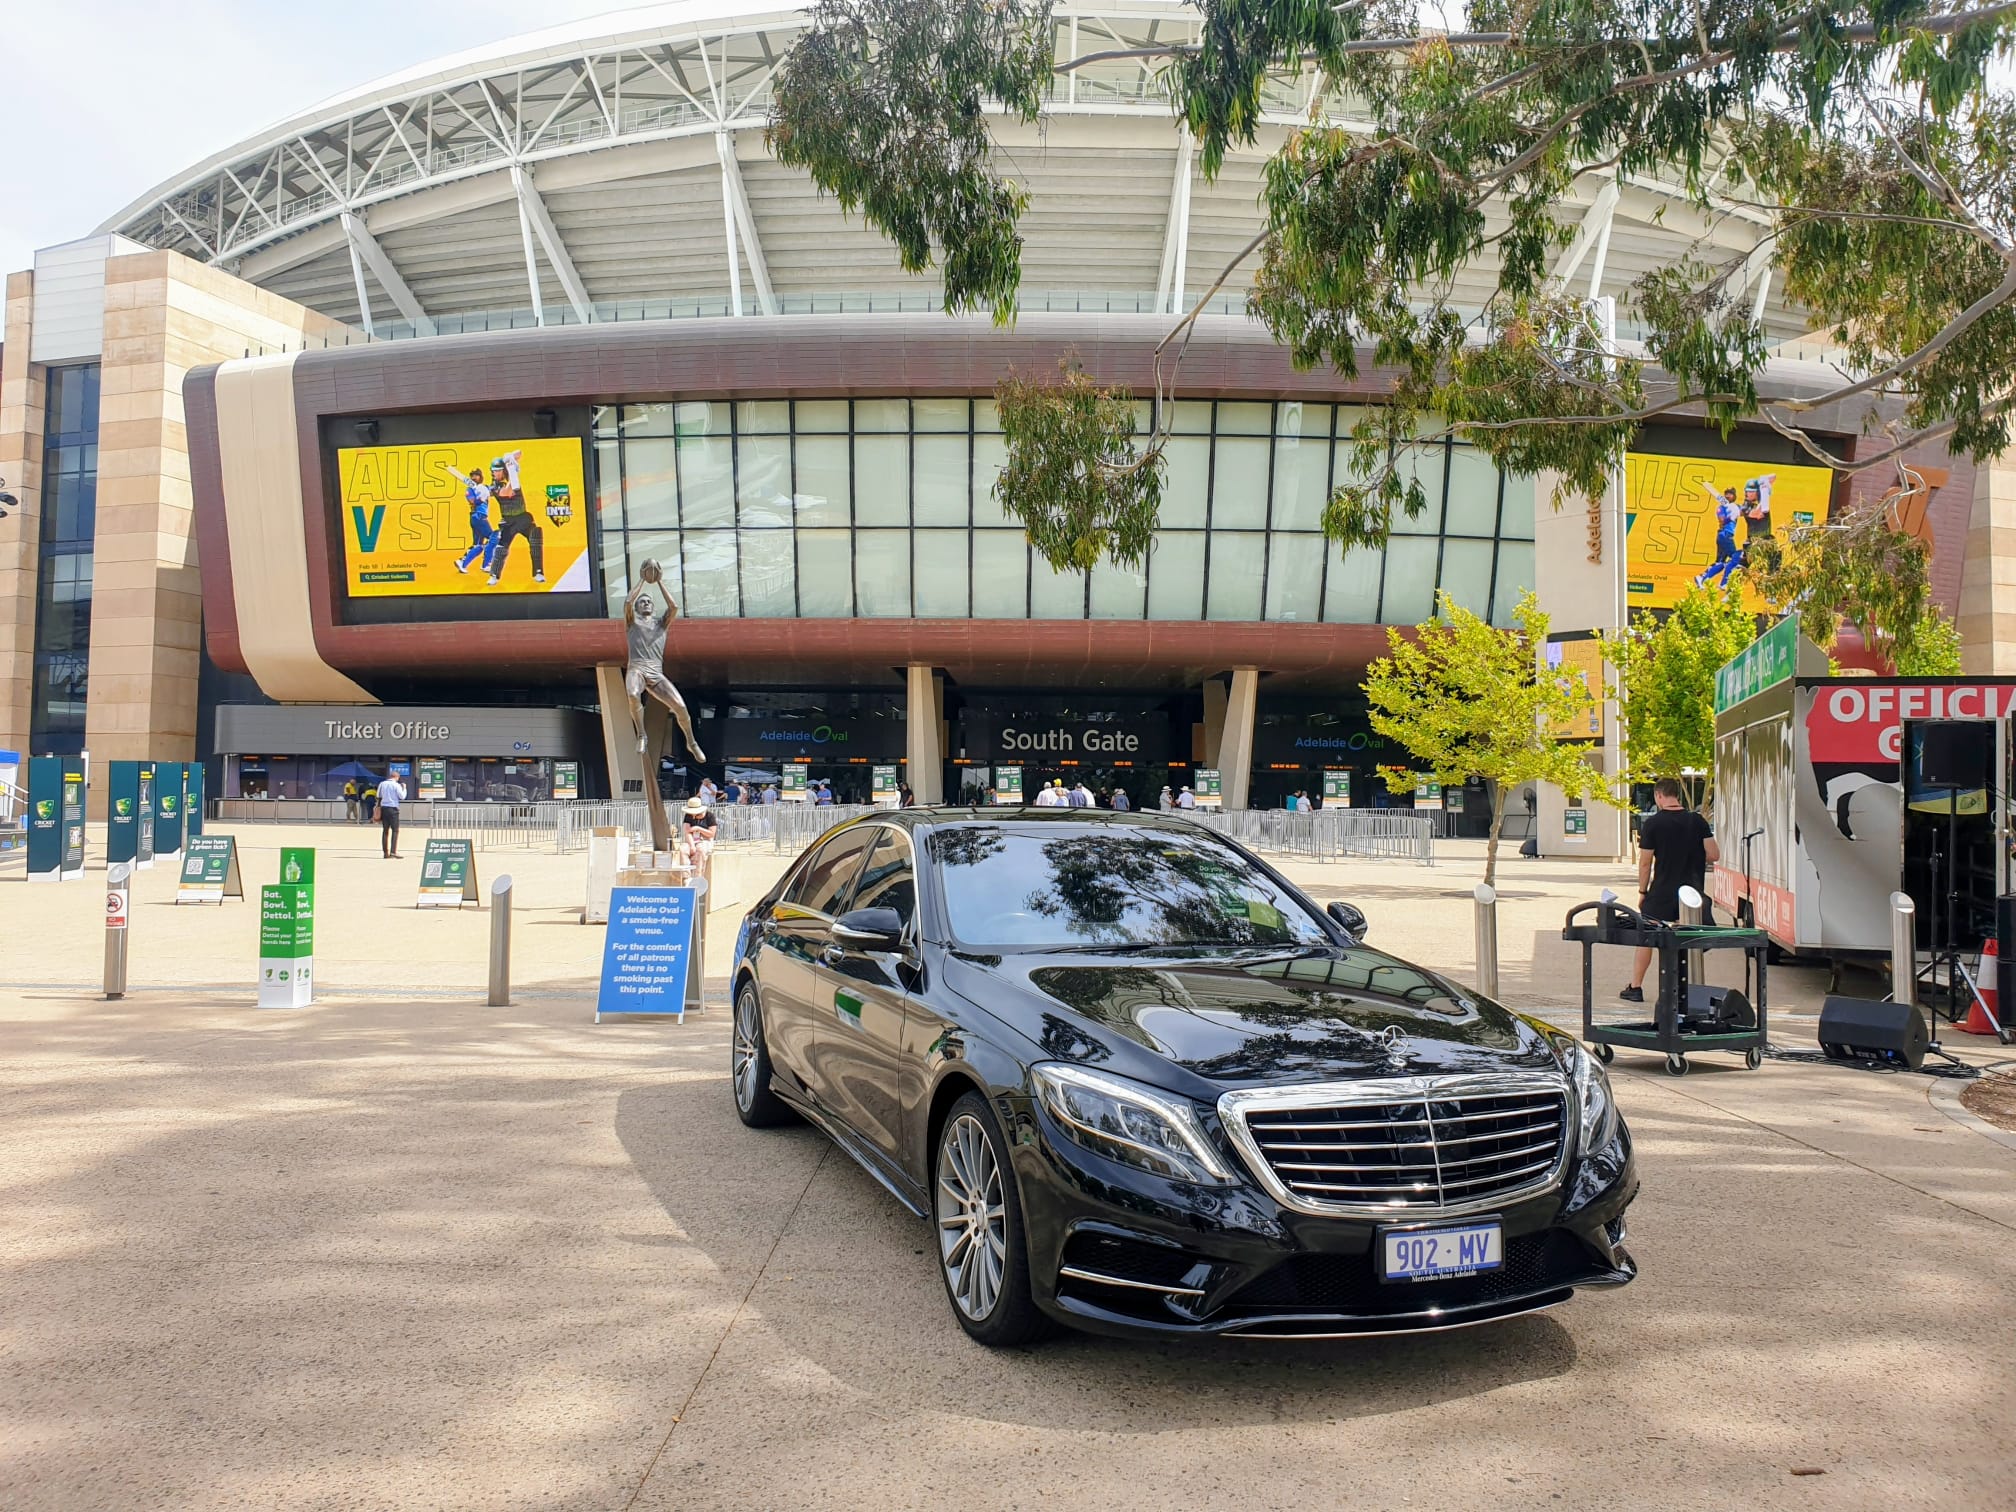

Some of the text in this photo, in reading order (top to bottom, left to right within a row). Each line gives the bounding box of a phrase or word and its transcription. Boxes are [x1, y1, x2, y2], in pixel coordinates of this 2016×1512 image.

[347, 449, 457, 502] AUS
[547, 506, 572, 516] INTL
[352, 501, 465, 553] V SL
[1643, 513, 1710, 566] SL
[325, 720, 450, 739] Ticket Office
[760, 725, 848, 743] Adelaide Oval
[1001, 728, 1139, 751] South Gate
[1295, 732, 1384, 751] Adelaide Oval
[263, 890, 282, 898] Bat.
[263, 901, 287, 909] Bowl.
[618, 906, 657, 914] Adelaide
[659, 906, 680, 914] Oval
[1757, 884, 1778, 932] GEAR
[263, 911, 294, 920] Dettol.
[629, 916, 679, 924] smoke-free
[612, 942, 682, 951] For the comfort
[617, 953, 675, 963] of all patrons
[621, 964, 645, 972] there
[647, 964, 654, 972] is
[613, 975, 674, 984] smoking past
[620, 985, 664, 995] this point.
[1396, 1232, 1490, 1271] 902 MV
[1409, 1264, 1477, 1276] SOUTH AUSTRALIA
[1454, 1269, 1477, 1278] Adelaide
